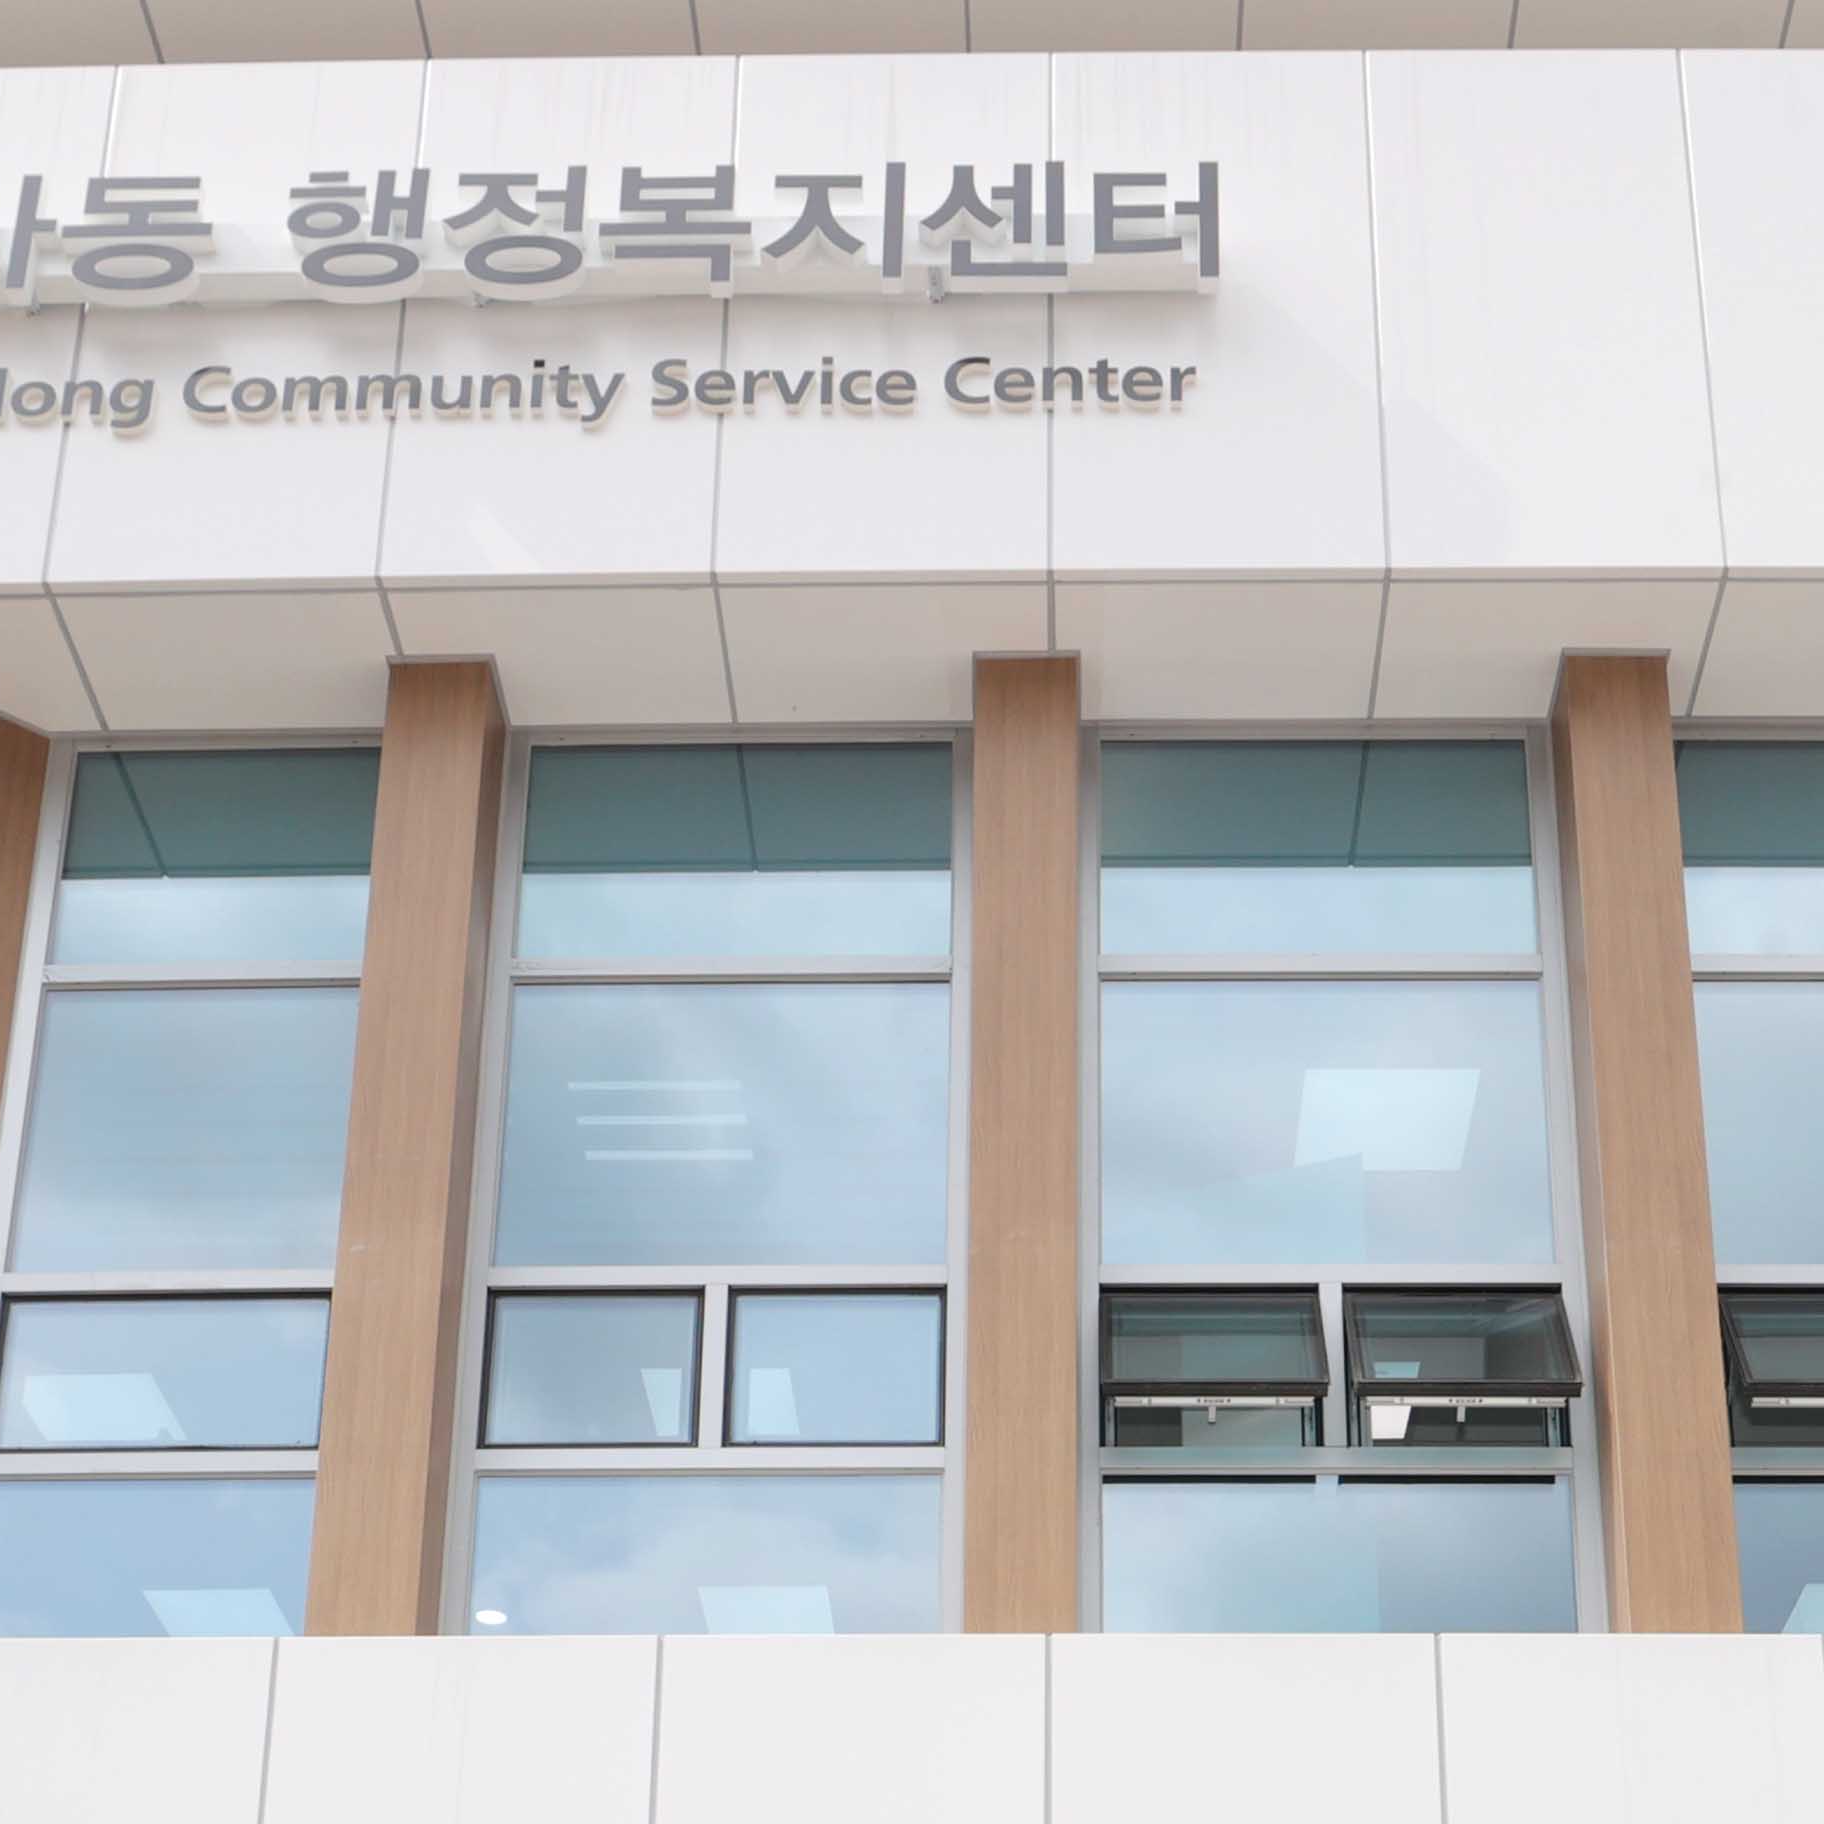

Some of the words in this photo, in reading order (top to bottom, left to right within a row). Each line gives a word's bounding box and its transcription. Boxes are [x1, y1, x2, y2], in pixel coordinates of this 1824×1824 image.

[284, 160, 1221, 294] 행정복지센터
[182, 357, 624, 422] Community
[650, 355, 917, 410] Service
[943, 355, 1196, 406] Center
